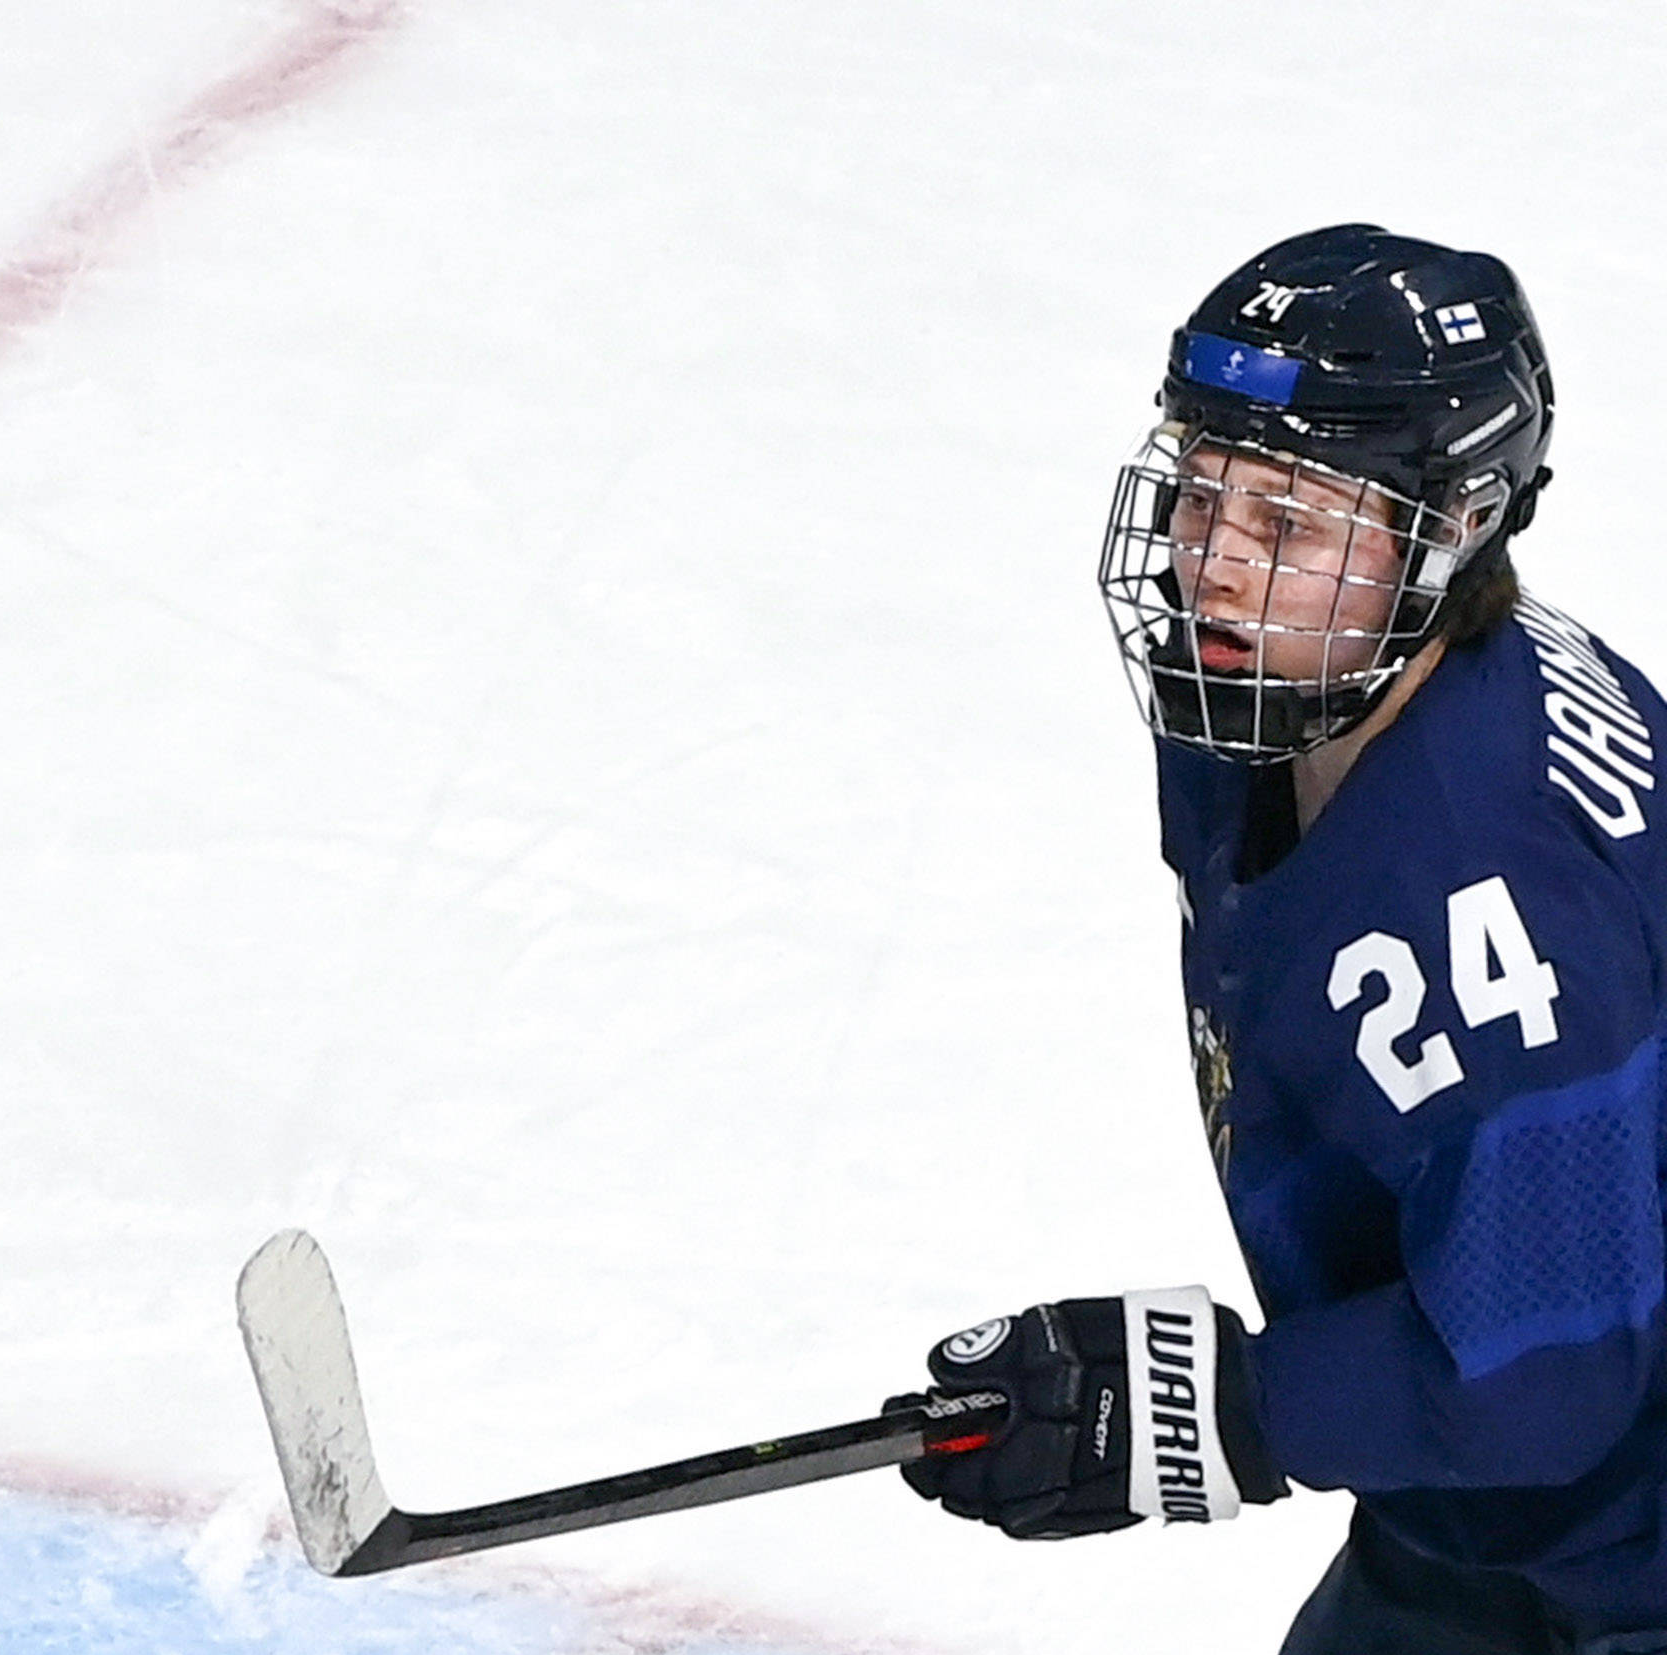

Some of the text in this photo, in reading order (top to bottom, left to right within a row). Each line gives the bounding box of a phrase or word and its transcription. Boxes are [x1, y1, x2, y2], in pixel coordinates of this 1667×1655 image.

[1240, 281, 1295, 322] 24
[1327, 875, 1560, 1114] 24
[1145, 1309, 1212, 1524] WARRIO
